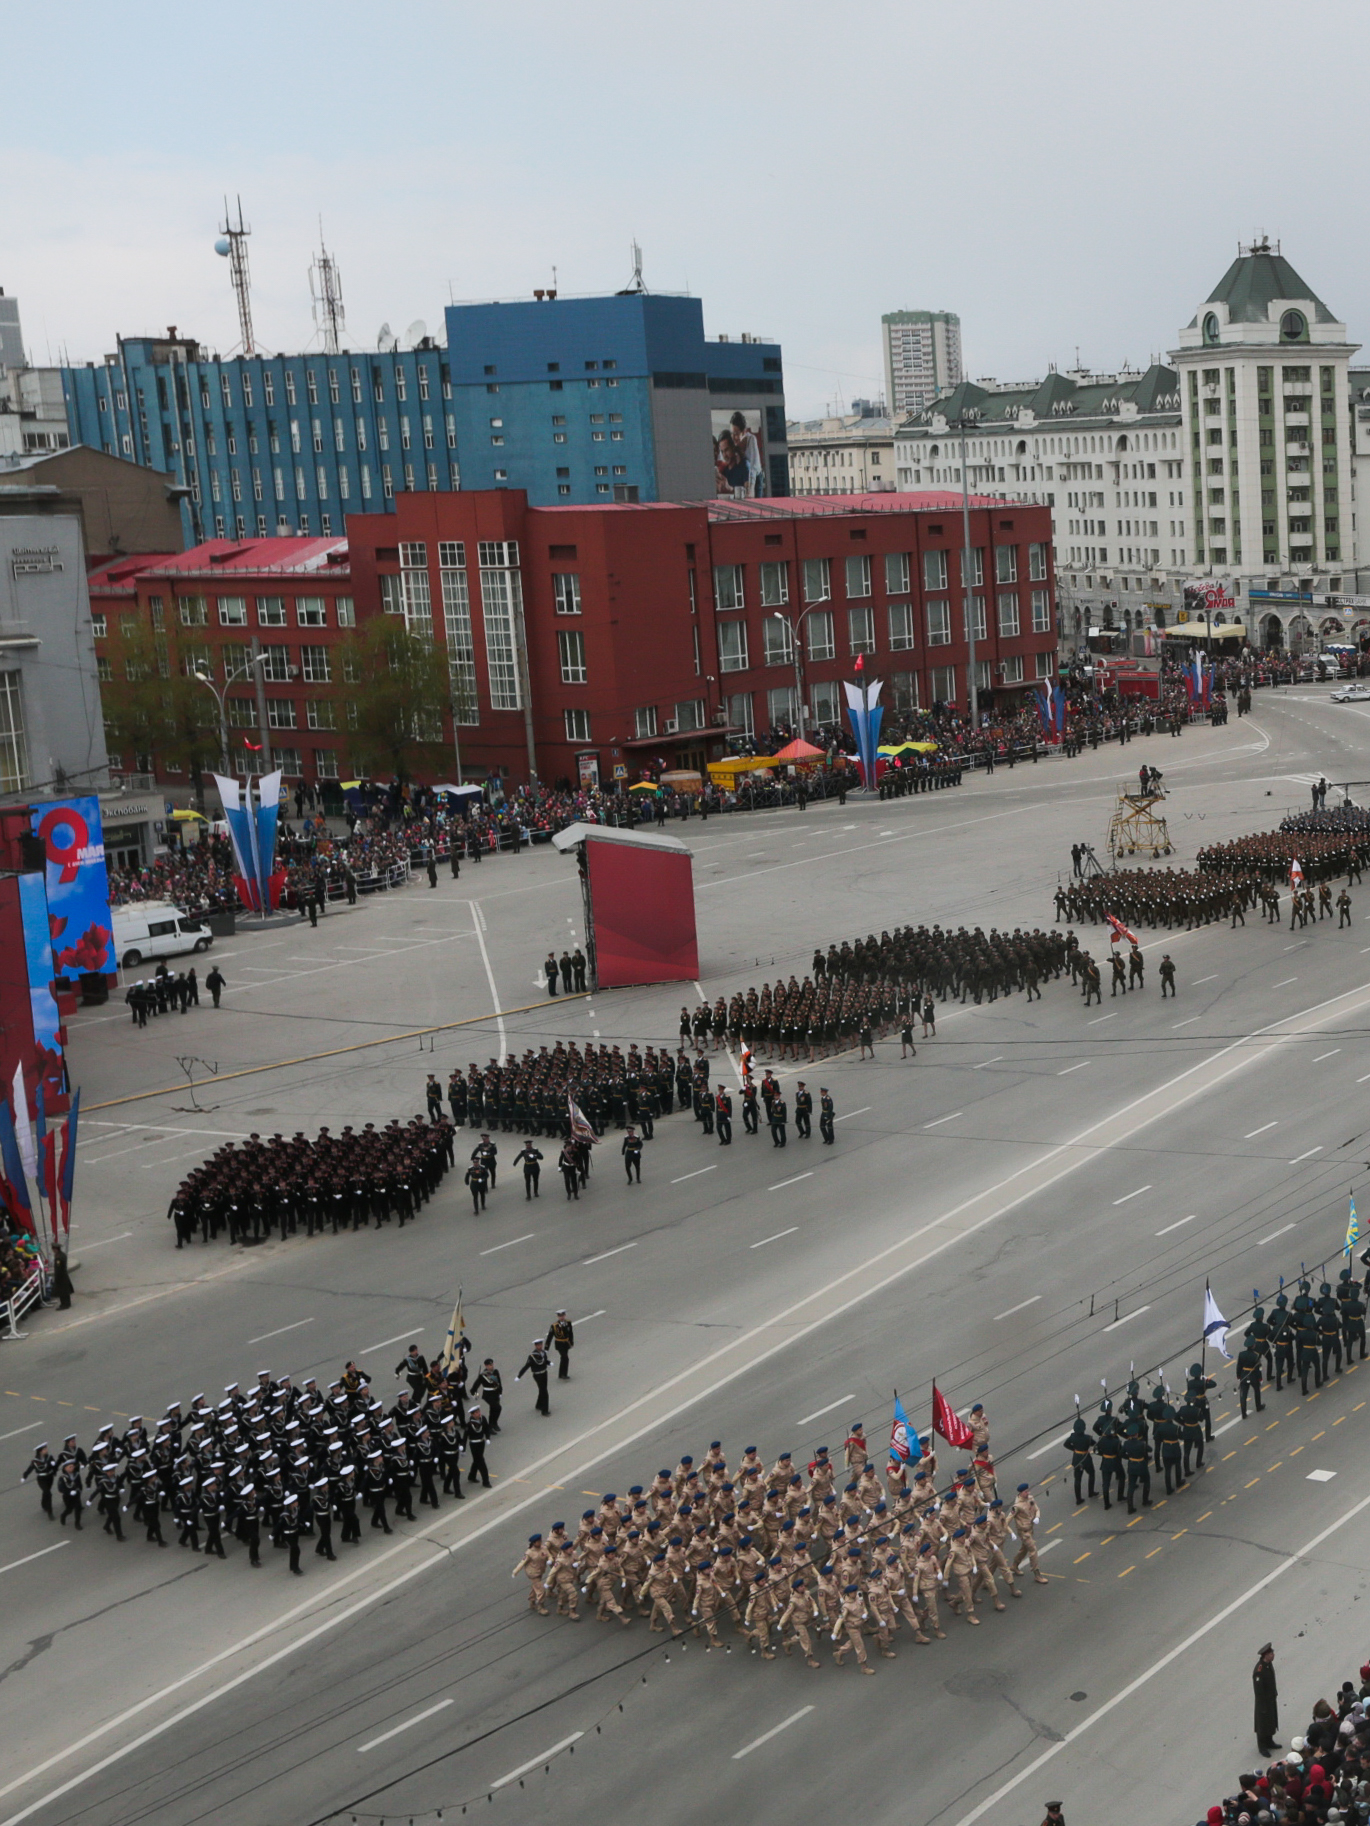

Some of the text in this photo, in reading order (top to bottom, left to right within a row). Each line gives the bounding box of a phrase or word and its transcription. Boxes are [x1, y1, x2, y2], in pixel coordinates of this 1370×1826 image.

[1214, 597, 1236, 609] МАЯ
[102, 804, 148, 818] Экспобанк
[39, 807, 88, 883] 9
[76, 844, 105, 860] МАЯ
